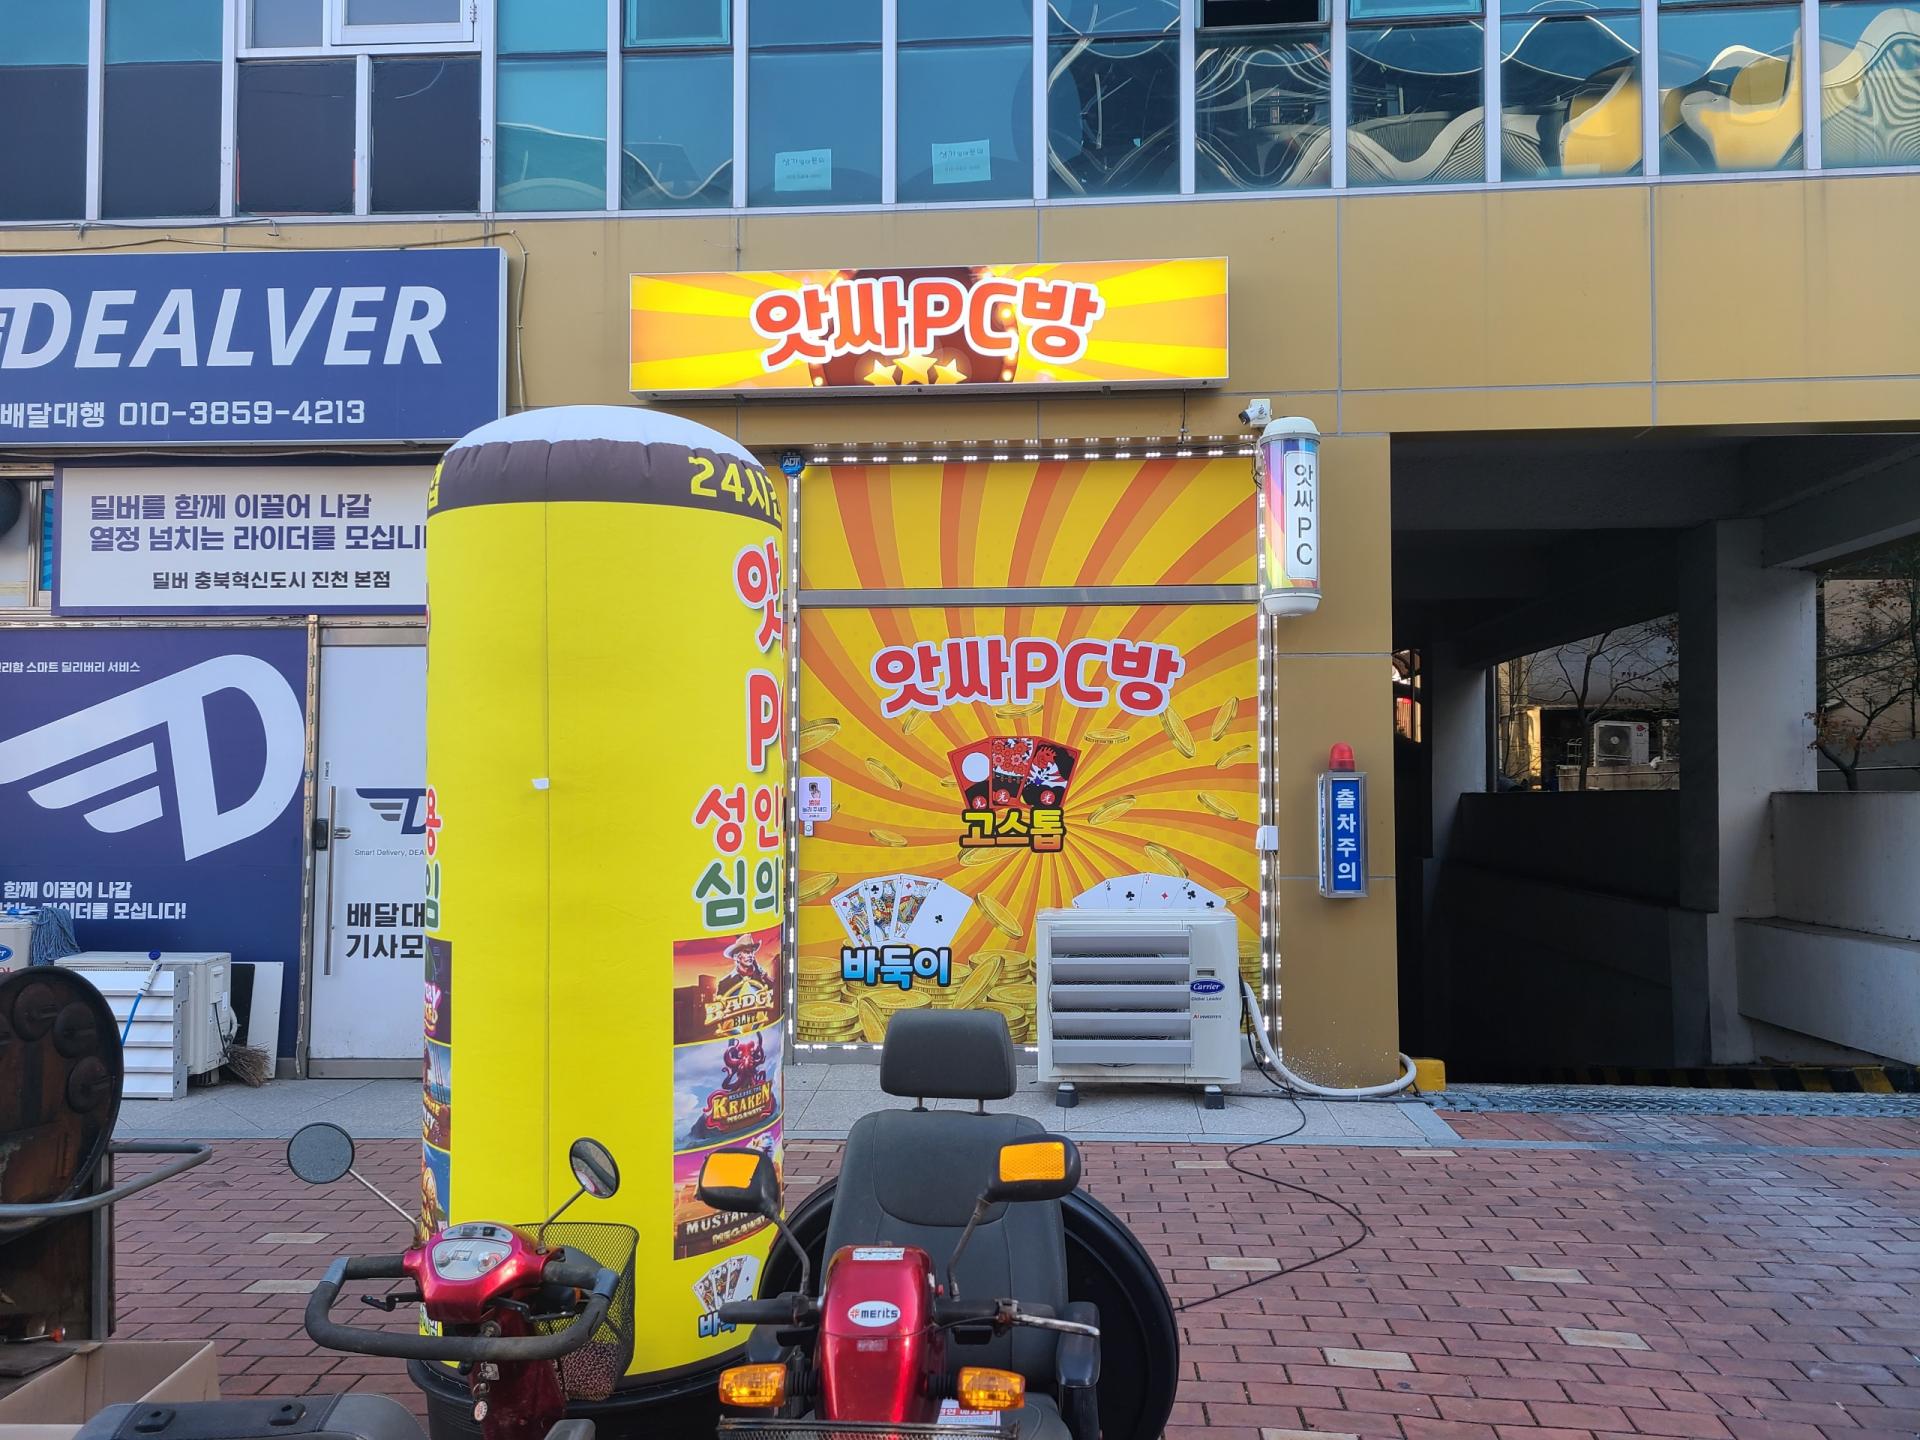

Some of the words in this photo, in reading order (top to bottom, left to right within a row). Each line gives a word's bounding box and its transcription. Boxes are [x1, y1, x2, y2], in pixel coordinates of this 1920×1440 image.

[0, 286, 447, 369] DEALVER
[752, 275, 1103, 370] 앗싸PC방
[0, 401, 105, 429] 배달대행
[119, 399, 366, 426] 010-3859-4213
[90, 493, 167, 521] 딜버를
[174, 493, 226, 520] 함께
[234, 492, 308, 520] 이끌어
[320, 492, 372, 520] 나갈
[89, 525, 141, 552] 열정
[148, 525, 225, 552] 넘치는
[233, 524, 337, 552] 라이더를
[345, 524, 427, 551] 모십니
[152, 572, 189, 590] 딜버
[194, 571, 306, 590] 충북혁신도시
[312, 571, 349, 590] 진천
[353, 571, 391, 590] 본점
[26, 661, 59, 673] 스마트
[61, 661, 105, 673] 딜리버리
[107, 661, 141, 673] 서비스
[874, 637, 1186, 715] 앗싸PC방
[694, 786, 783, 853] 성인
[959, 808, 1067, 853] 고스톱
[4, 881, 38, 899] 함께
[43, 881, 92, 899] 이끌어
[98, 881, 132, 899] 나갈
[694, 856, 783, 928] 심의
[114, 902, 186, 920] 모십니다!
[841, 945, 953, 991] 바둑이
[713, 1082, 771, 1119] KRAKEN
[686, 1211, 749, 1236] MUSTA
[712, 1214, 767, 1246] MEGAWAY
[861, 1309, 898, 1319] merits
